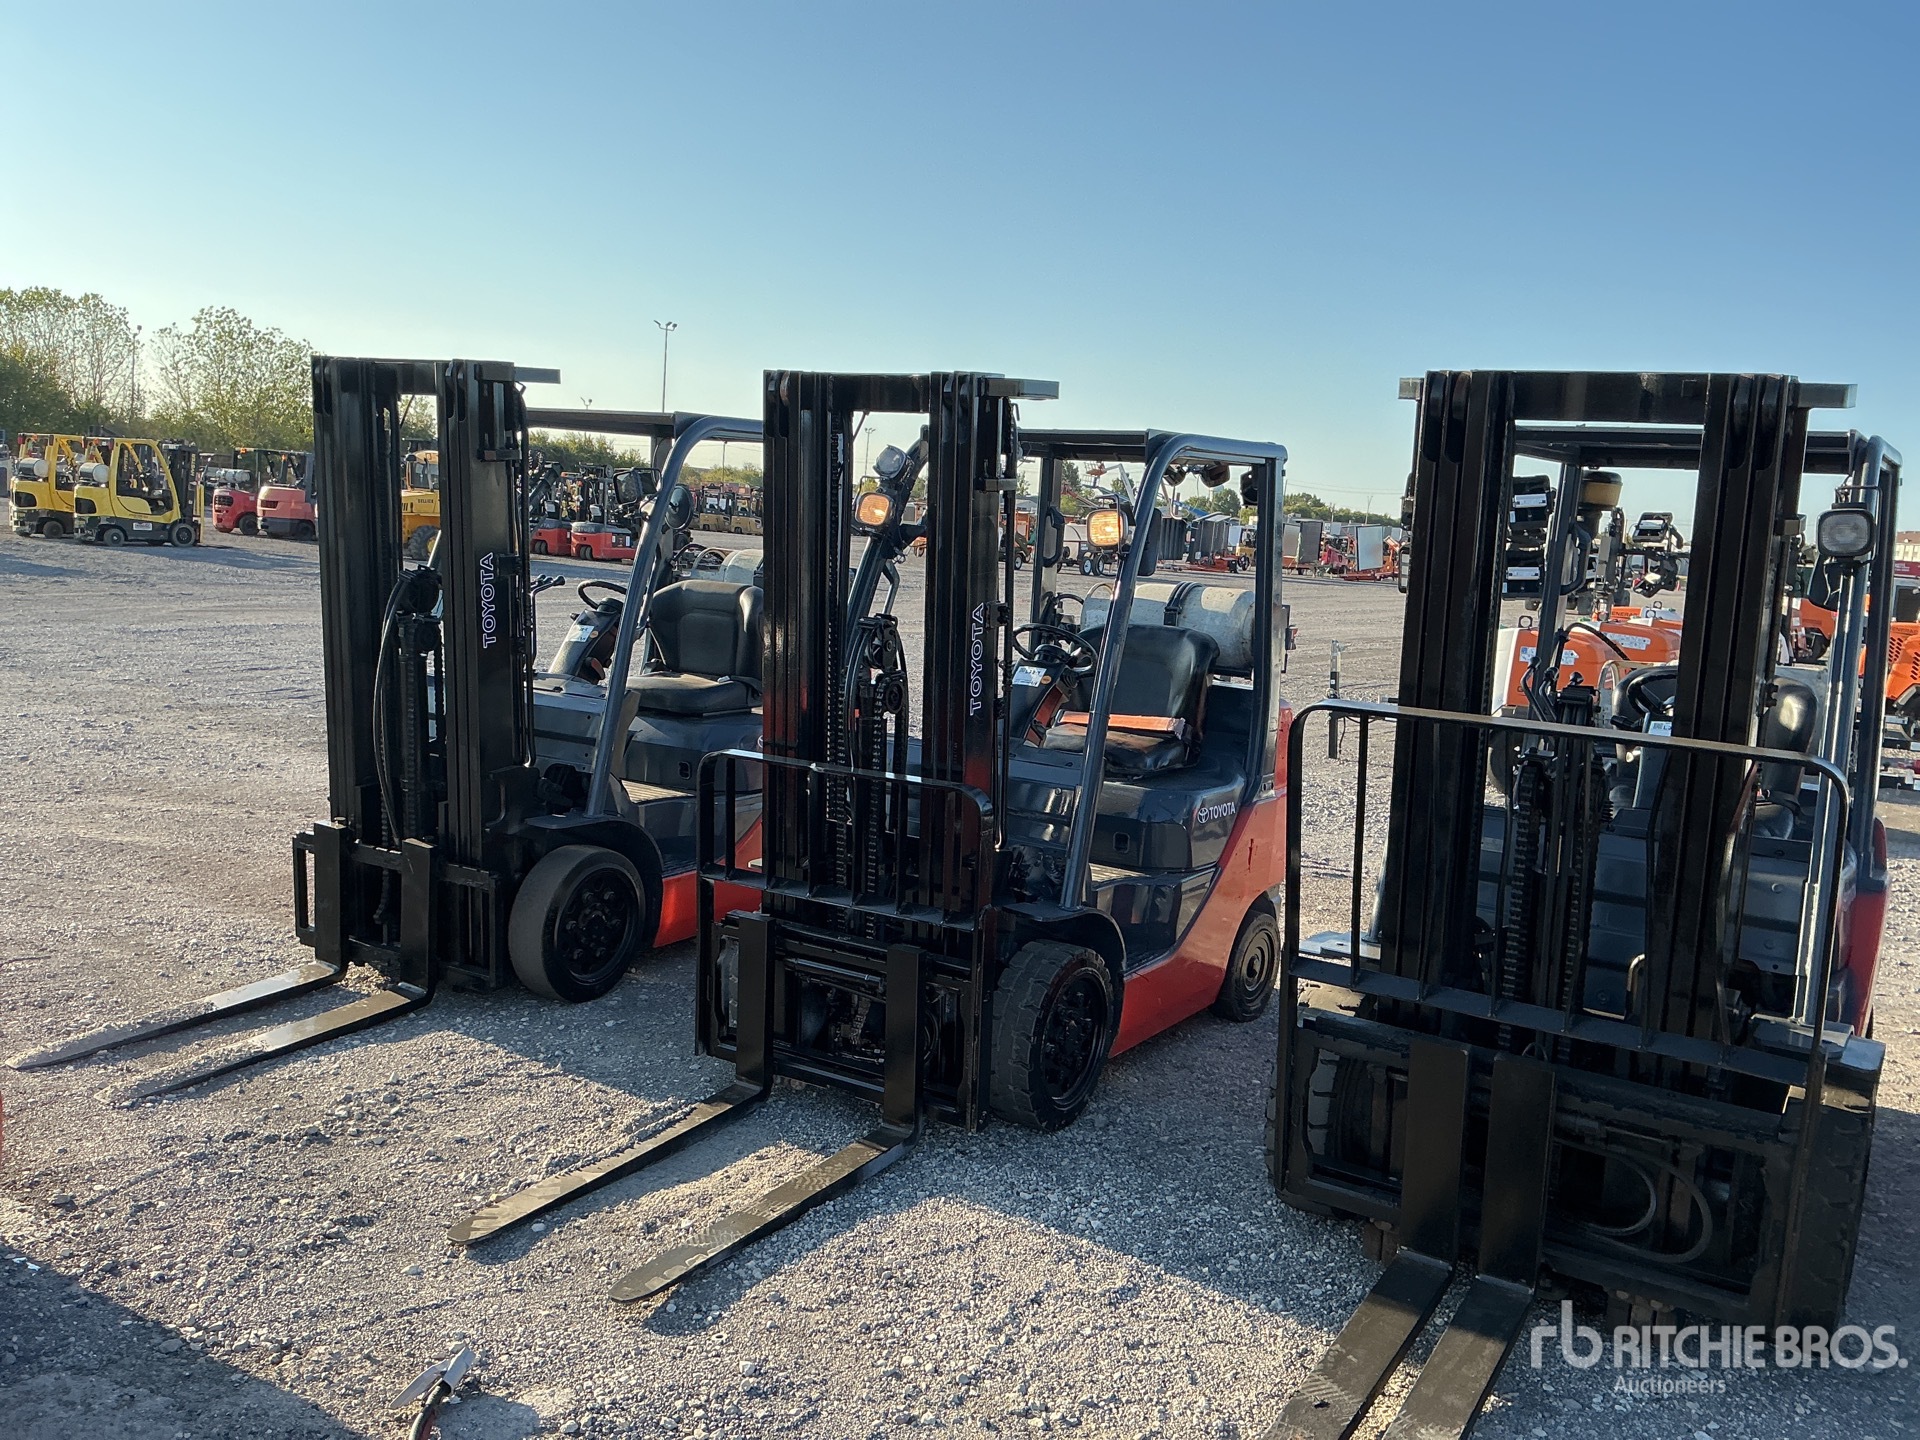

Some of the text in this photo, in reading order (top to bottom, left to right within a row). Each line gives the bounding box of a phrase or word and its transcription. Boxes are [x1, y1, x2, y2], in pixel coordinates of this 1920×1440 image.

[480, 552, 497, 649] TOYOTA
[969, 602, 984, 717] TOYOTA
[1209, 801, 1236, 820] TOYOTA
